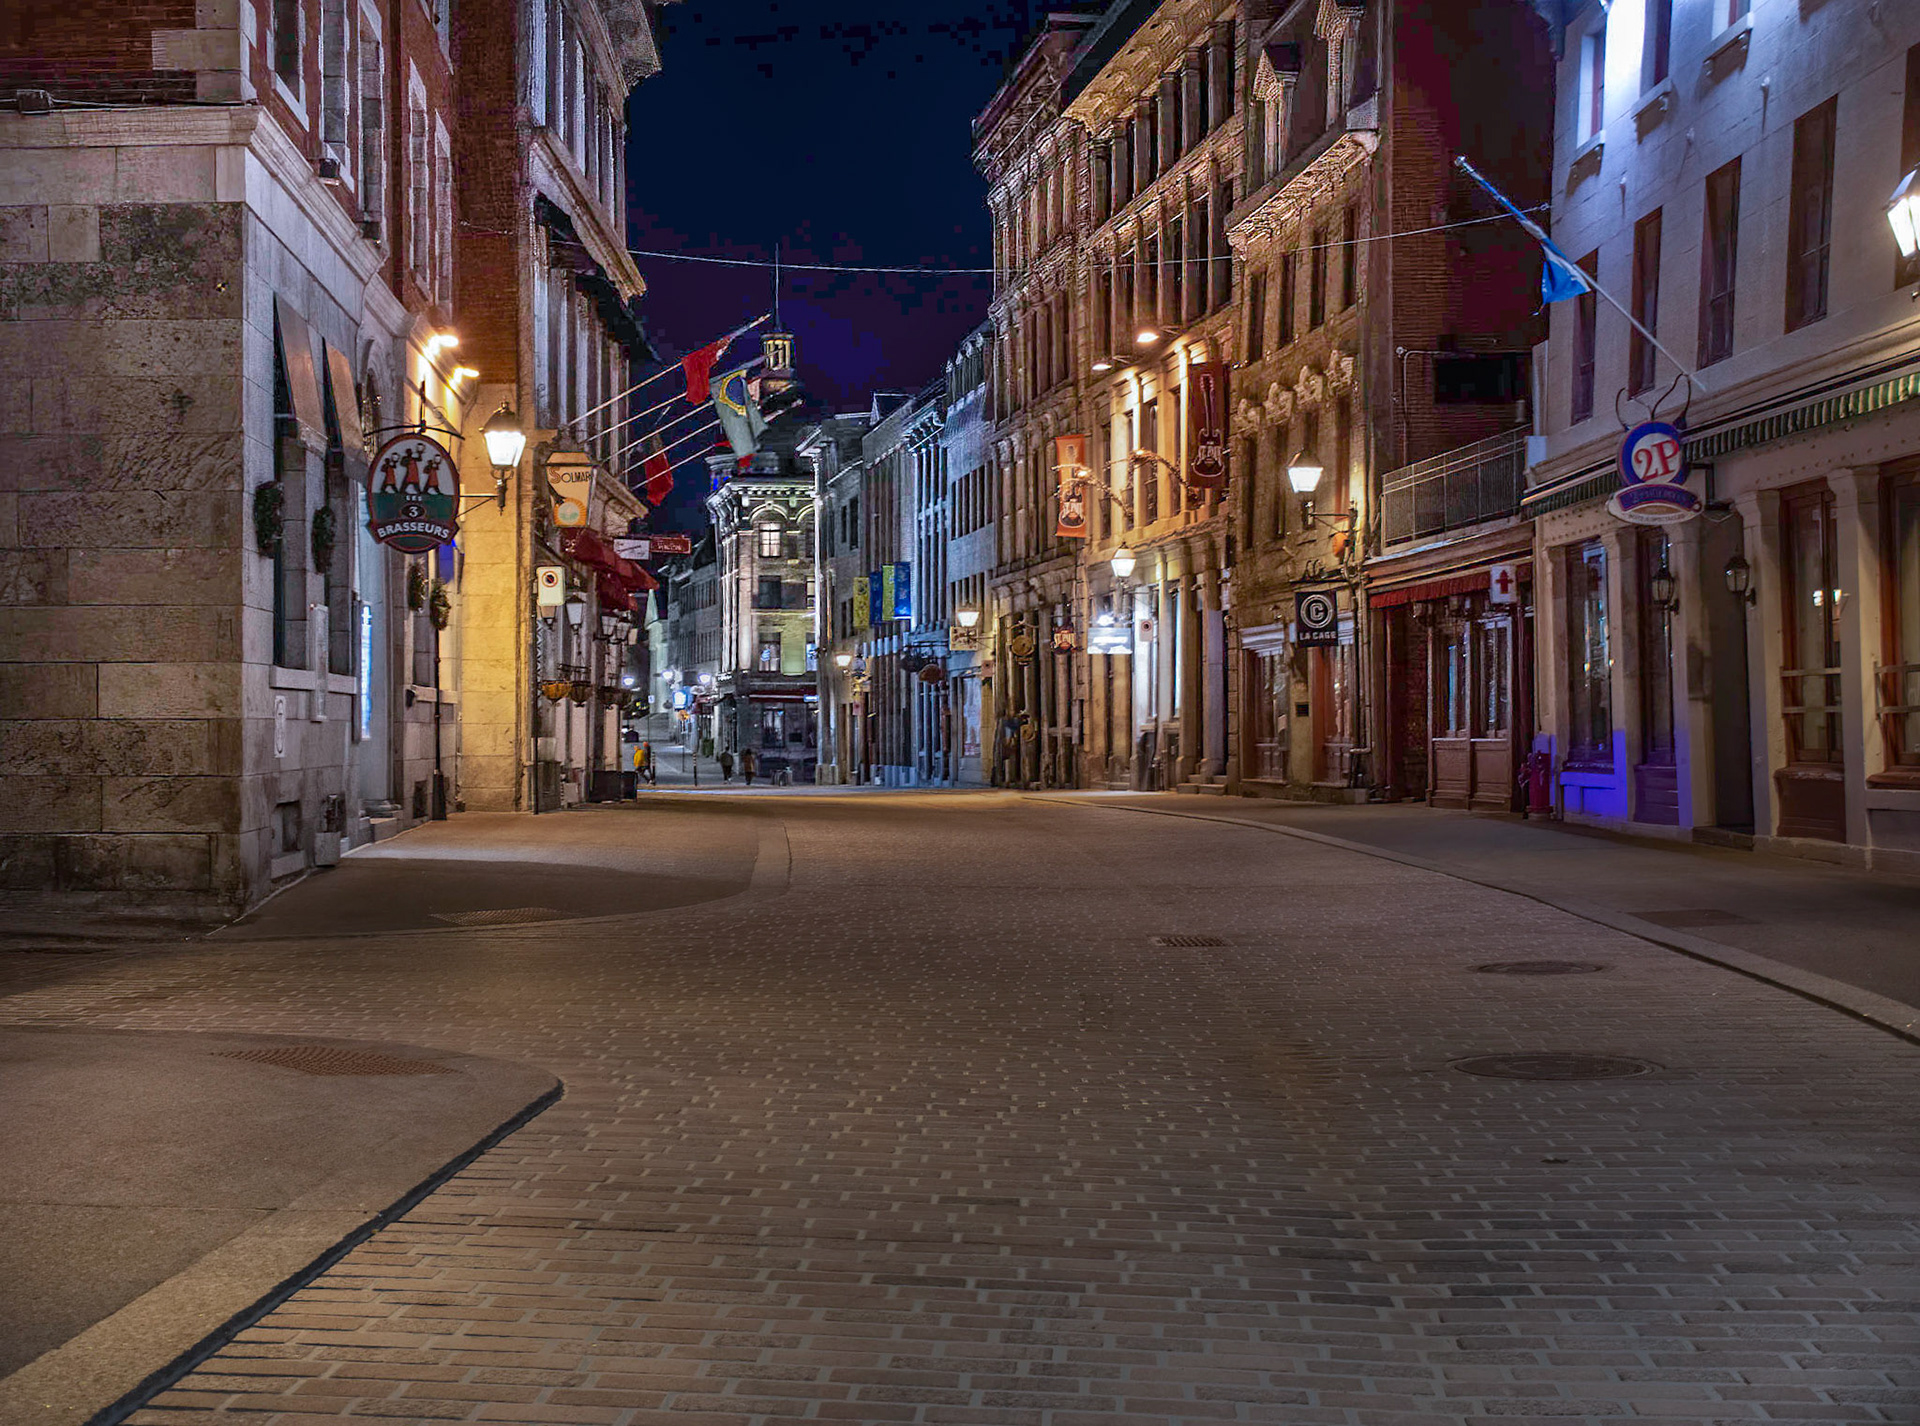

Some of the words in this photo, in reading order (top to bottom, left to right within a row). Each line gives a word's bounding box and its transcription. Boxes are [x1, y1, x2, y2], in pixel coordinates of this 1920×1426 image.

[1633, 438, 1680, 482] 2P
[549, 466, 592, 484] SOLMAR
[408, 506, 419, 518] 3
[377, 522, 450, 539] BRASSEURS
[1299, 632, 1311, 641] LA
[1312, 631, 1337, 640] CAGE
